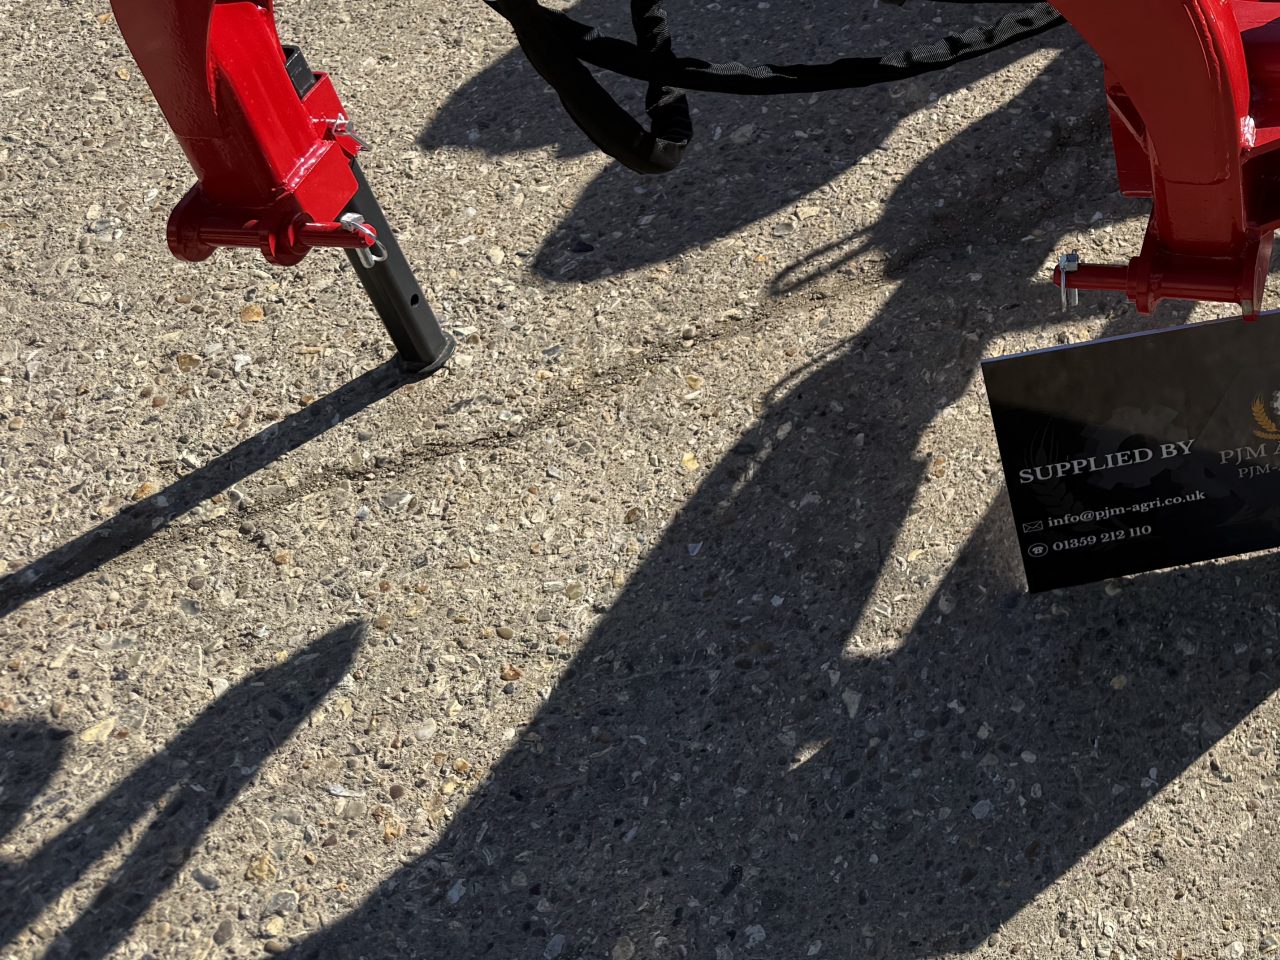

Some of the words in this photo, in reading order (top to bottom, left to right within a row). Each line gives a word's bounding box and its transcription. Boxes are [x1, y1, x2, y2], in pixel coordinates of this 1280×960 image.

[1019, 447, 1153, 484] SUPPLIED
[1159, 439, 1195, 459] BY
[1219, 443, 1267, 465] PJM
[1048, 490, 1206, 527] info@pjm-agri.co.uk
[1053, 536, 1097, 551] 01359
[1100, 530, 1125, 543] 212
[1130, 525, 1152, 537] 110
